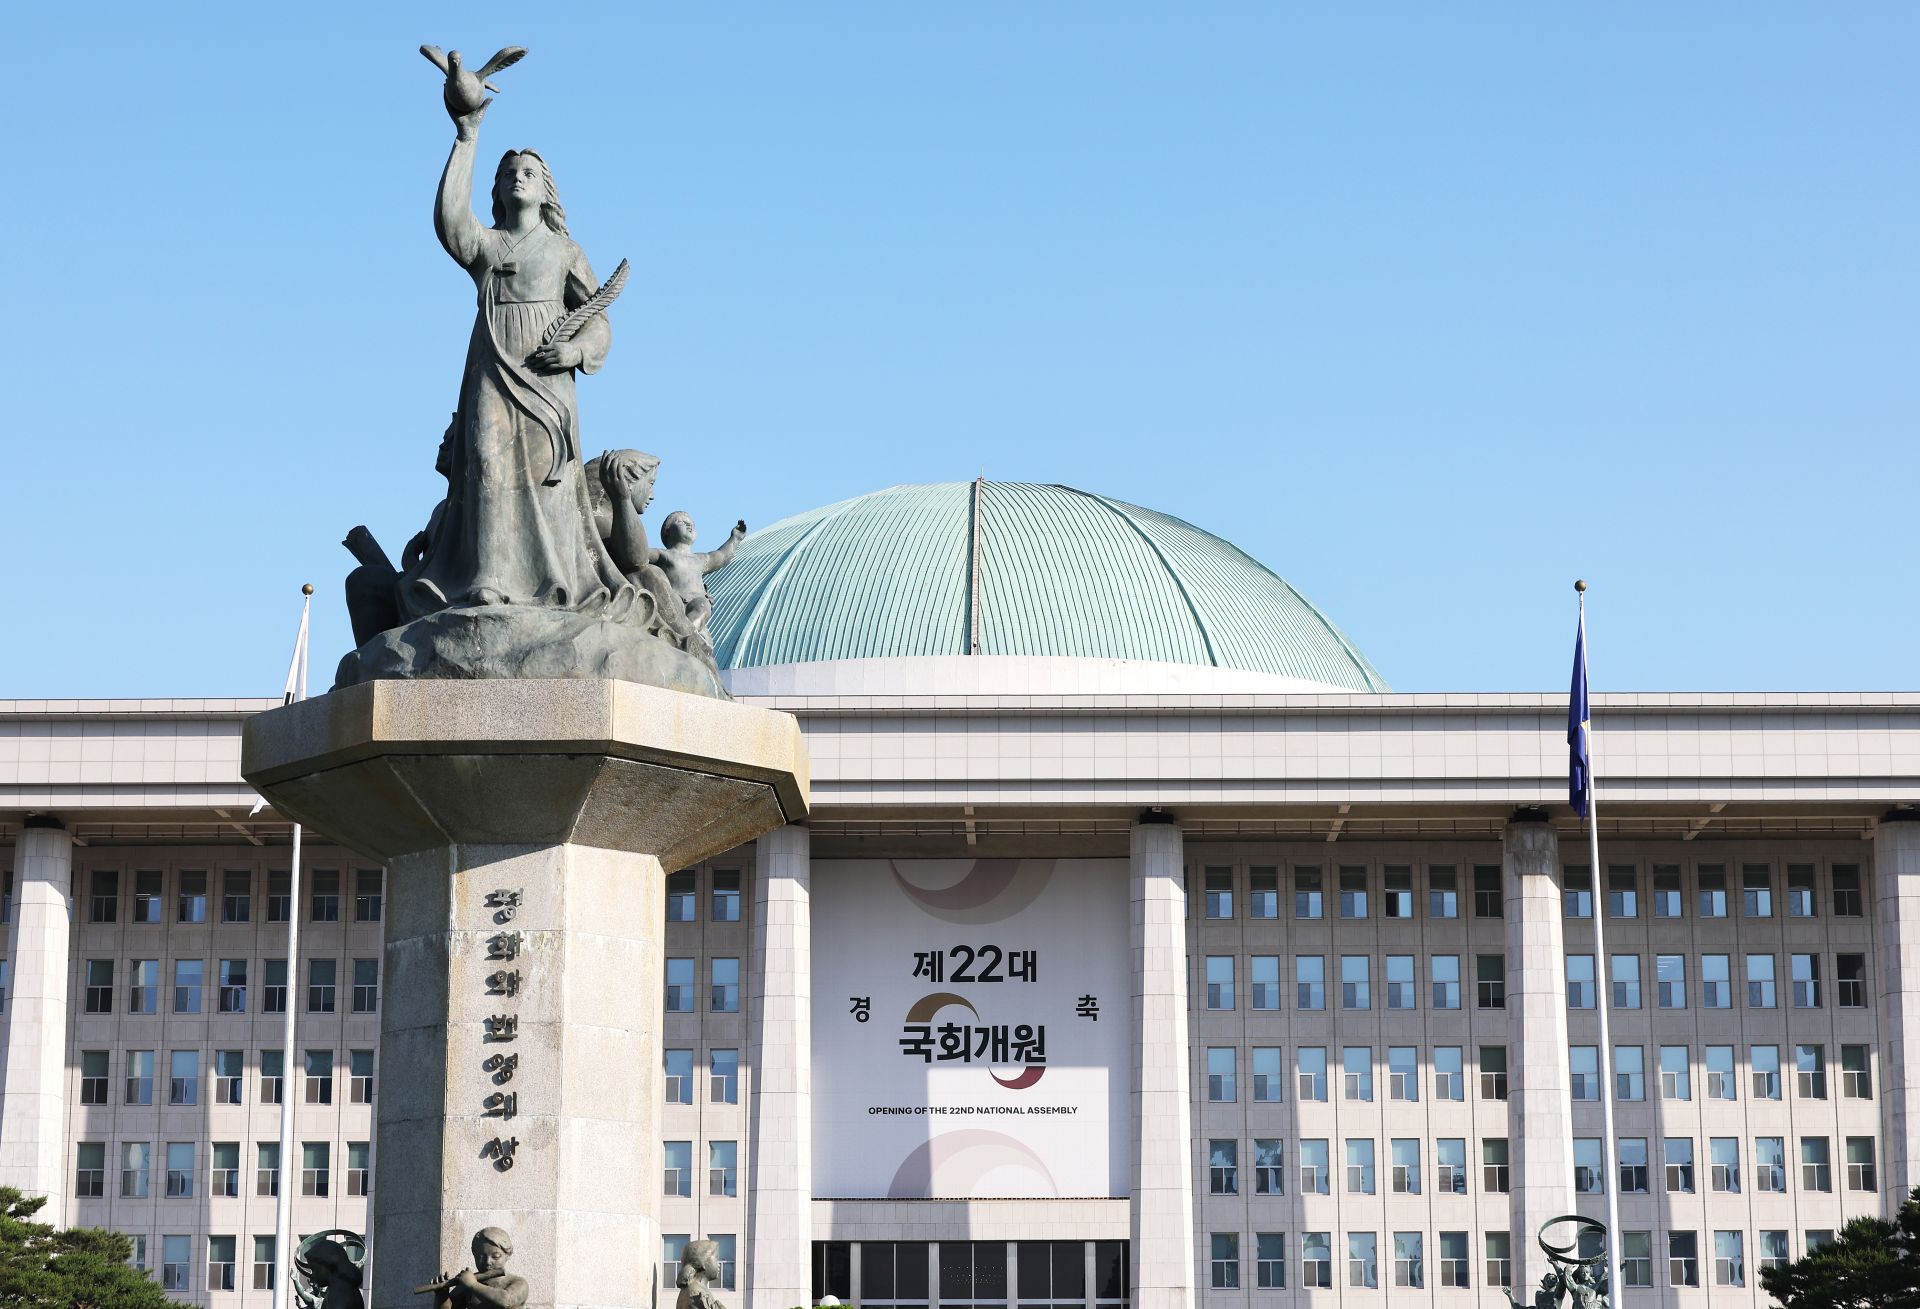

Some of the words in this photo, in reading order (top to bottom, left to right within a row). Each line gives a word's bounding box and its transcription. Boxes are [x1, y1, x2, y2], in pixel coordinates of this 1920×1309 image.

[490, 887, 525, 993] 평화와
[912, 944, 1037, 983] 제22대
[849, 996, 871, 1023] 경
[1075, 994, 1100, 1021] 축
[899, 1022, 1047, 1063] 국회개원
[488, 1013, 519, 1117] 번영의
[868, 1106, 913, 1115] OPENING
[914, 1106, 928, 1115] OF
[929, 1106, 947, 1115] THE
[949, 1106, 975, 1115] 22ND
[976, 1106, 1025, 1115] NATIONAL
[1027, 1106, 1078, 1115] ASSEMBLY
[490, 1136, 520, 1170] 상
